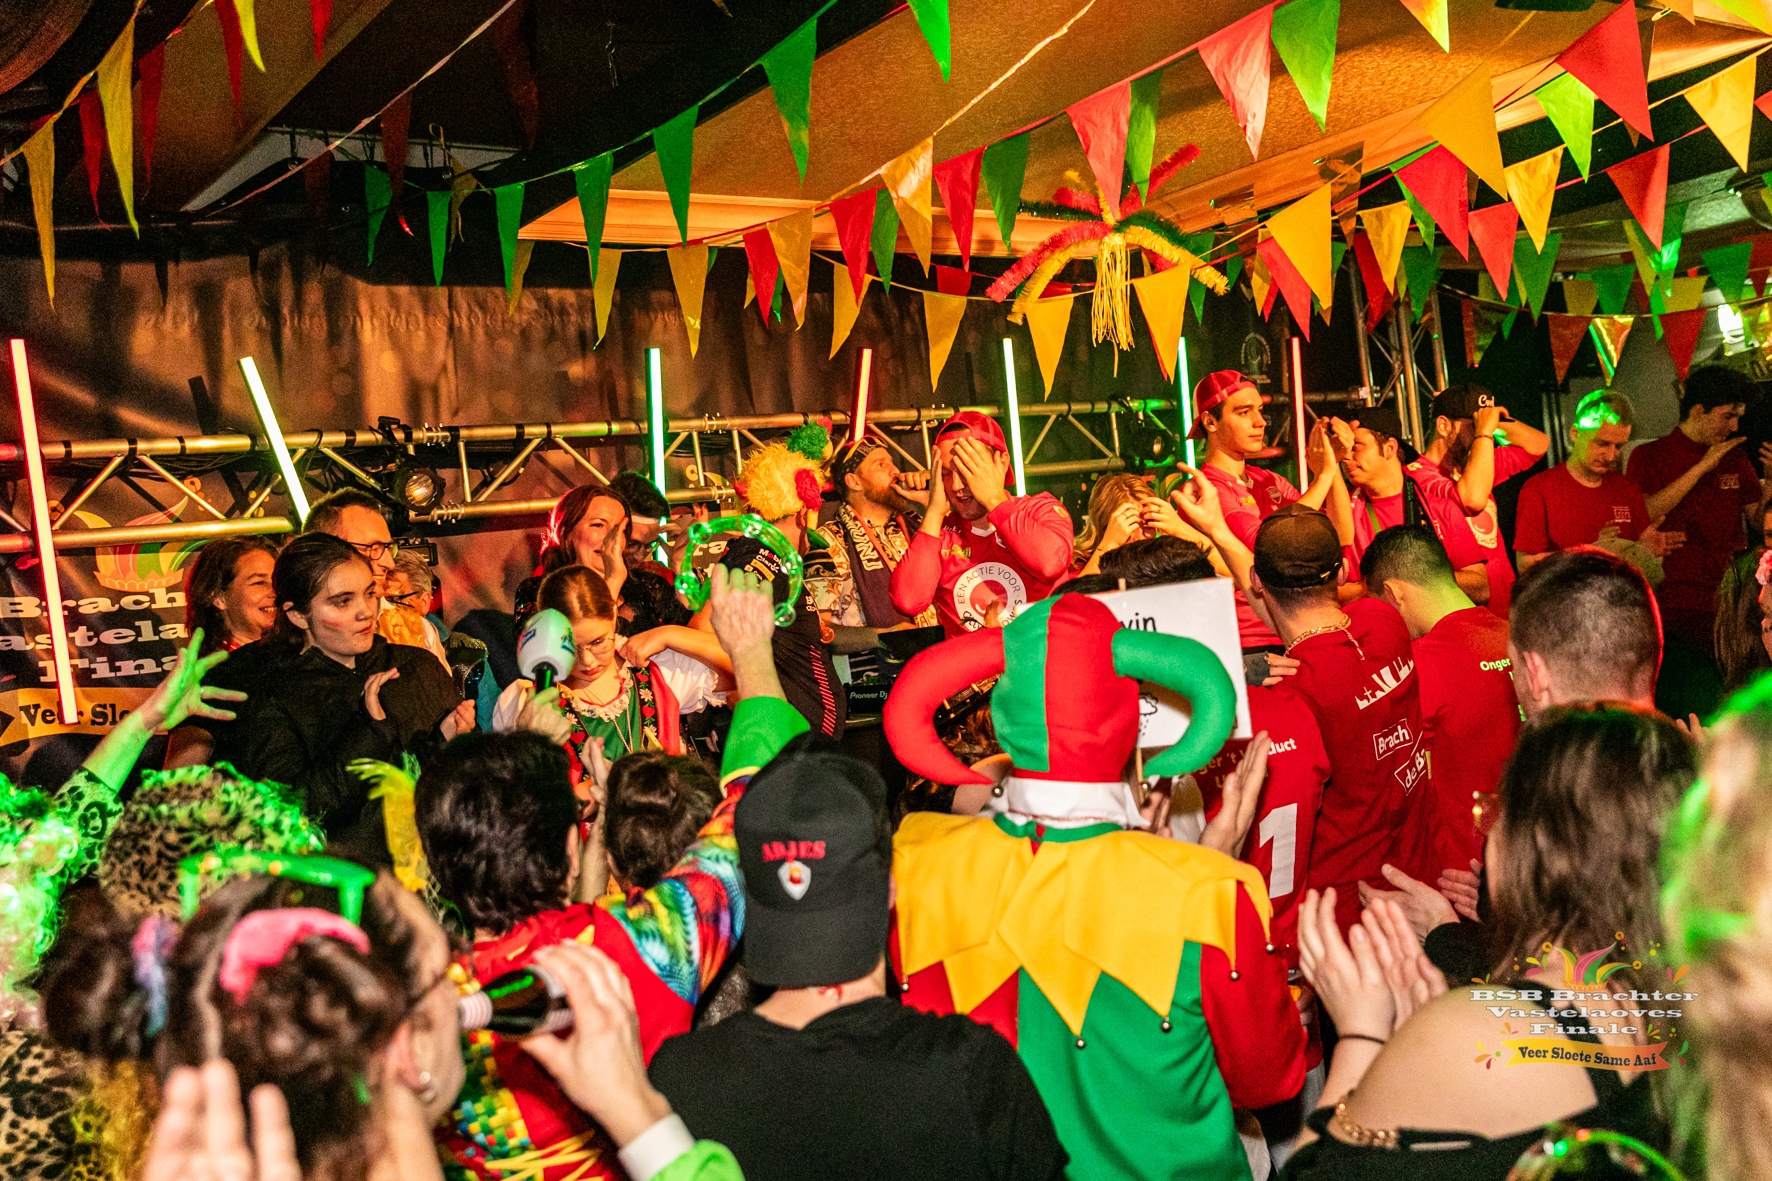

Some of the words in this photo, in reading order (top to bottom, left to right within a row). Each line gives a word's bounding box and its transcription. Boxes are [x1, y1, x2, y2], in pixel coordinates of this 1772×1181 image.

[957, 583, 968, 605] EEN
[966, 566, 995, 585] ACTIE
[997, 567, 1021, 593] VOOR
[1480, 658, 1511, 671] Onger
[850, 691, 878, 699] Pioneer
[1378, 725, 1409, 754] Brach
[1405, 768, 1418, 789] de
[1259, 803, 1297, 899] 1
